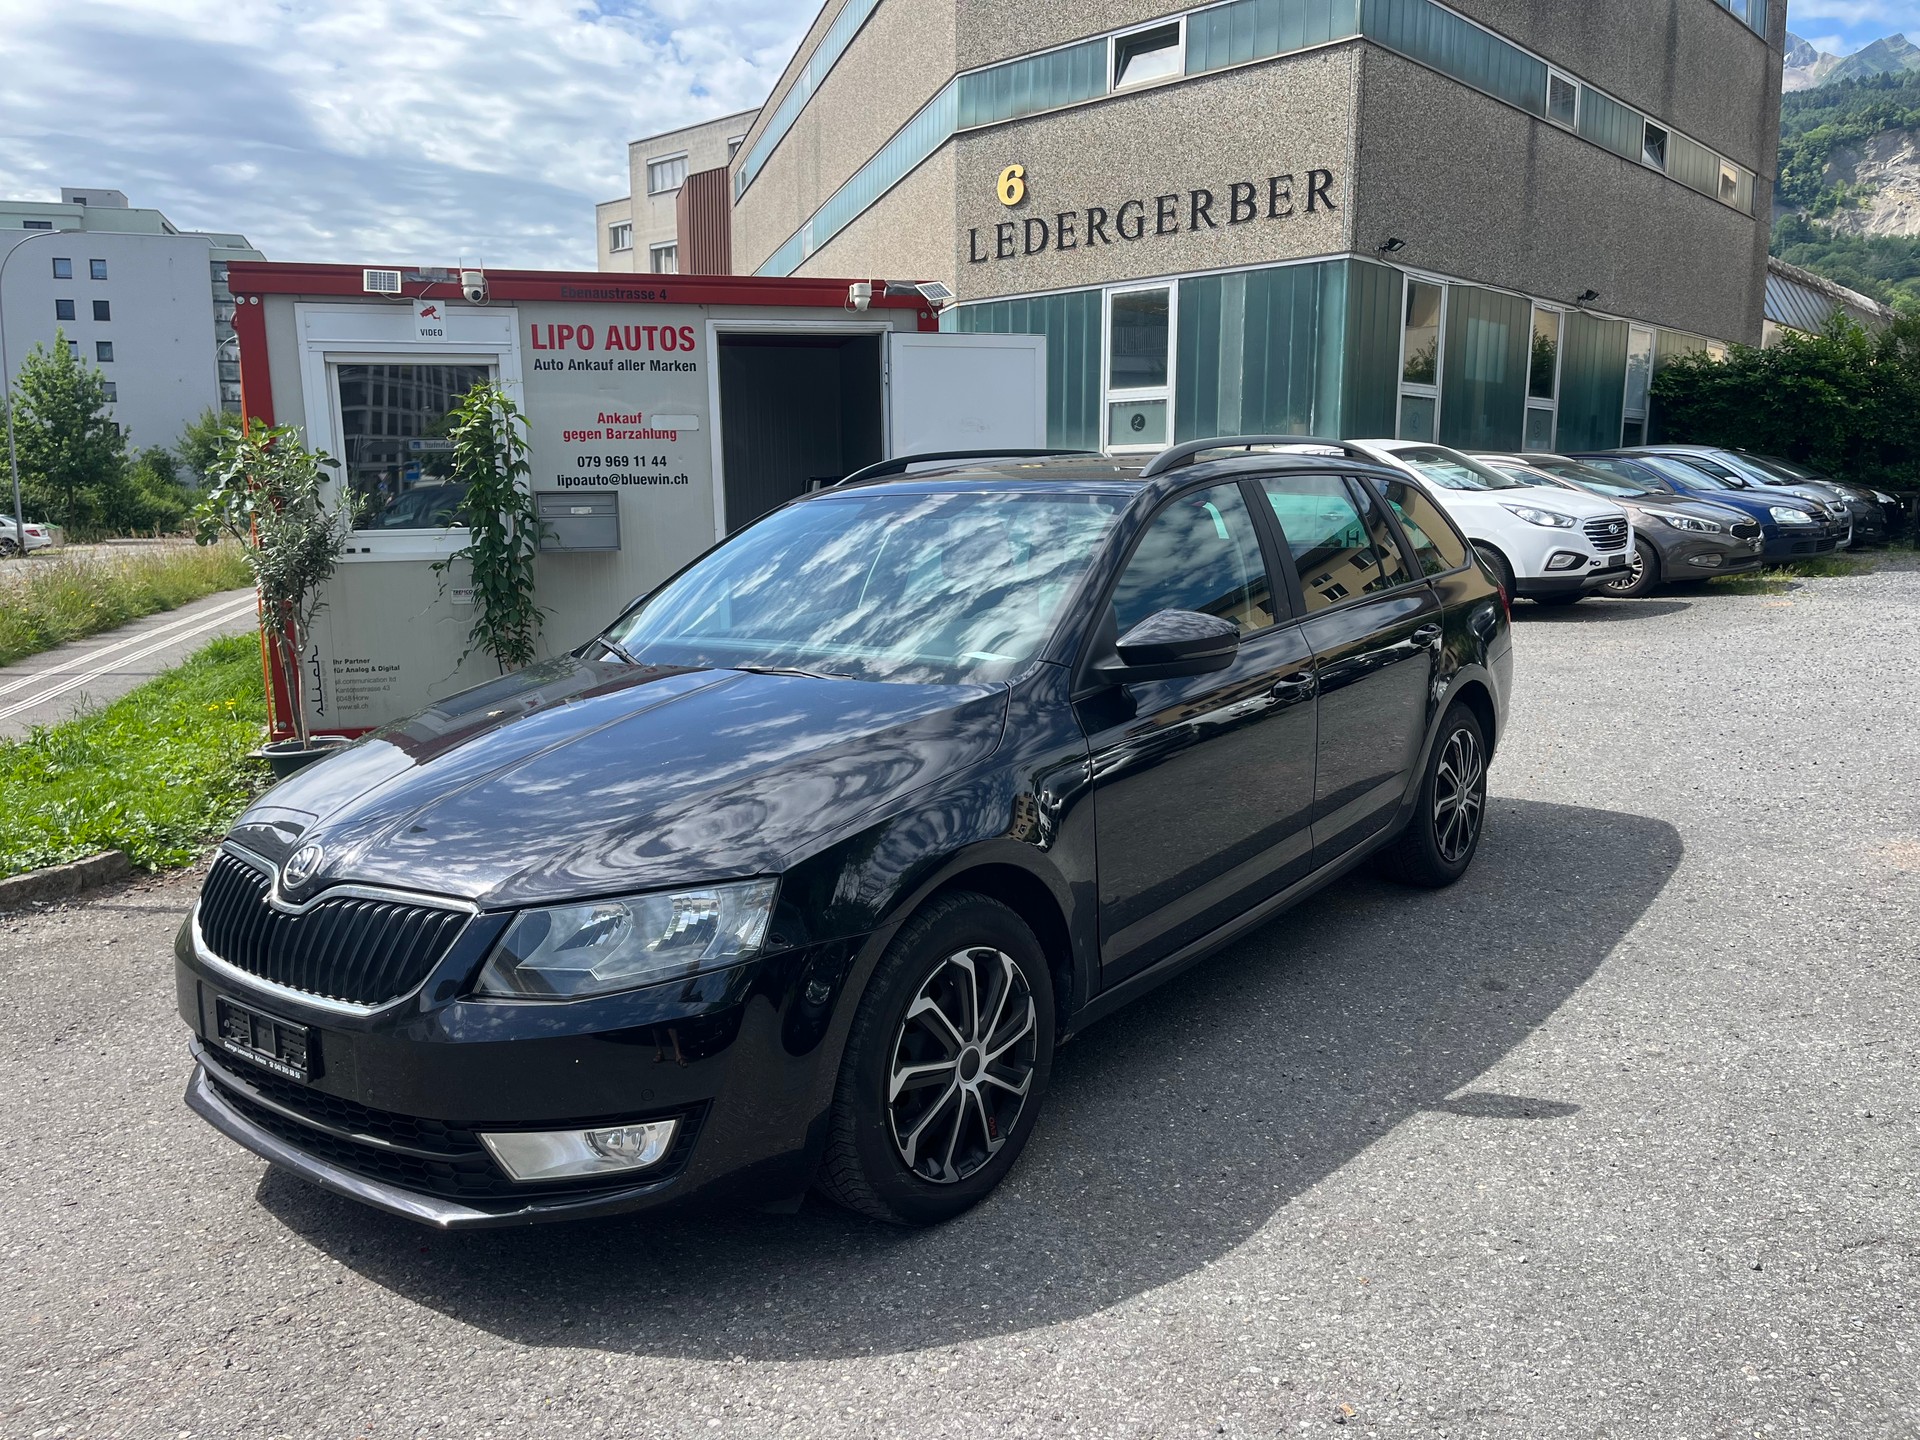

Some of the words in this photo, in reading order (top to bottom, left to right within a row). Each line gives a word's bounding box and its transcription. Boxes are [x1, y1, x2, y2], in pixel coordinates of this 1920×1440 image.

[997, 164, 1025, 206] 6
[967, 168, 1338, 263] LEDERGERBER
[561, 285, 656, 300] Ebenaustrasse
[660, 288, 667, 300] 4
[420, 328, 443, 337] VIDEO
[531, 323, 595, 351] LIPO
[605, 325, 696, 352] AUTOS
[534, 358, 564, 371] Auto
[568, 359, 614, 371] Ankauf
[617, 359, 646, 372] aller
[650, 360, 697, 372] Marken
[597, 412, 642, 424] Ankauf
[563, 429, 602, 442] gegen
[606, 428, 677, 442] Barzahlung
[577, 456, 601, 468] 079
[605, 455, 629, 467] 969
[633, 456, 646, 467] 11
[651, 456, 667, 467] 44
[557, 473, 688, 488] lipoauto@bluewin.ch
[378, 665, 400, 673] Digital
